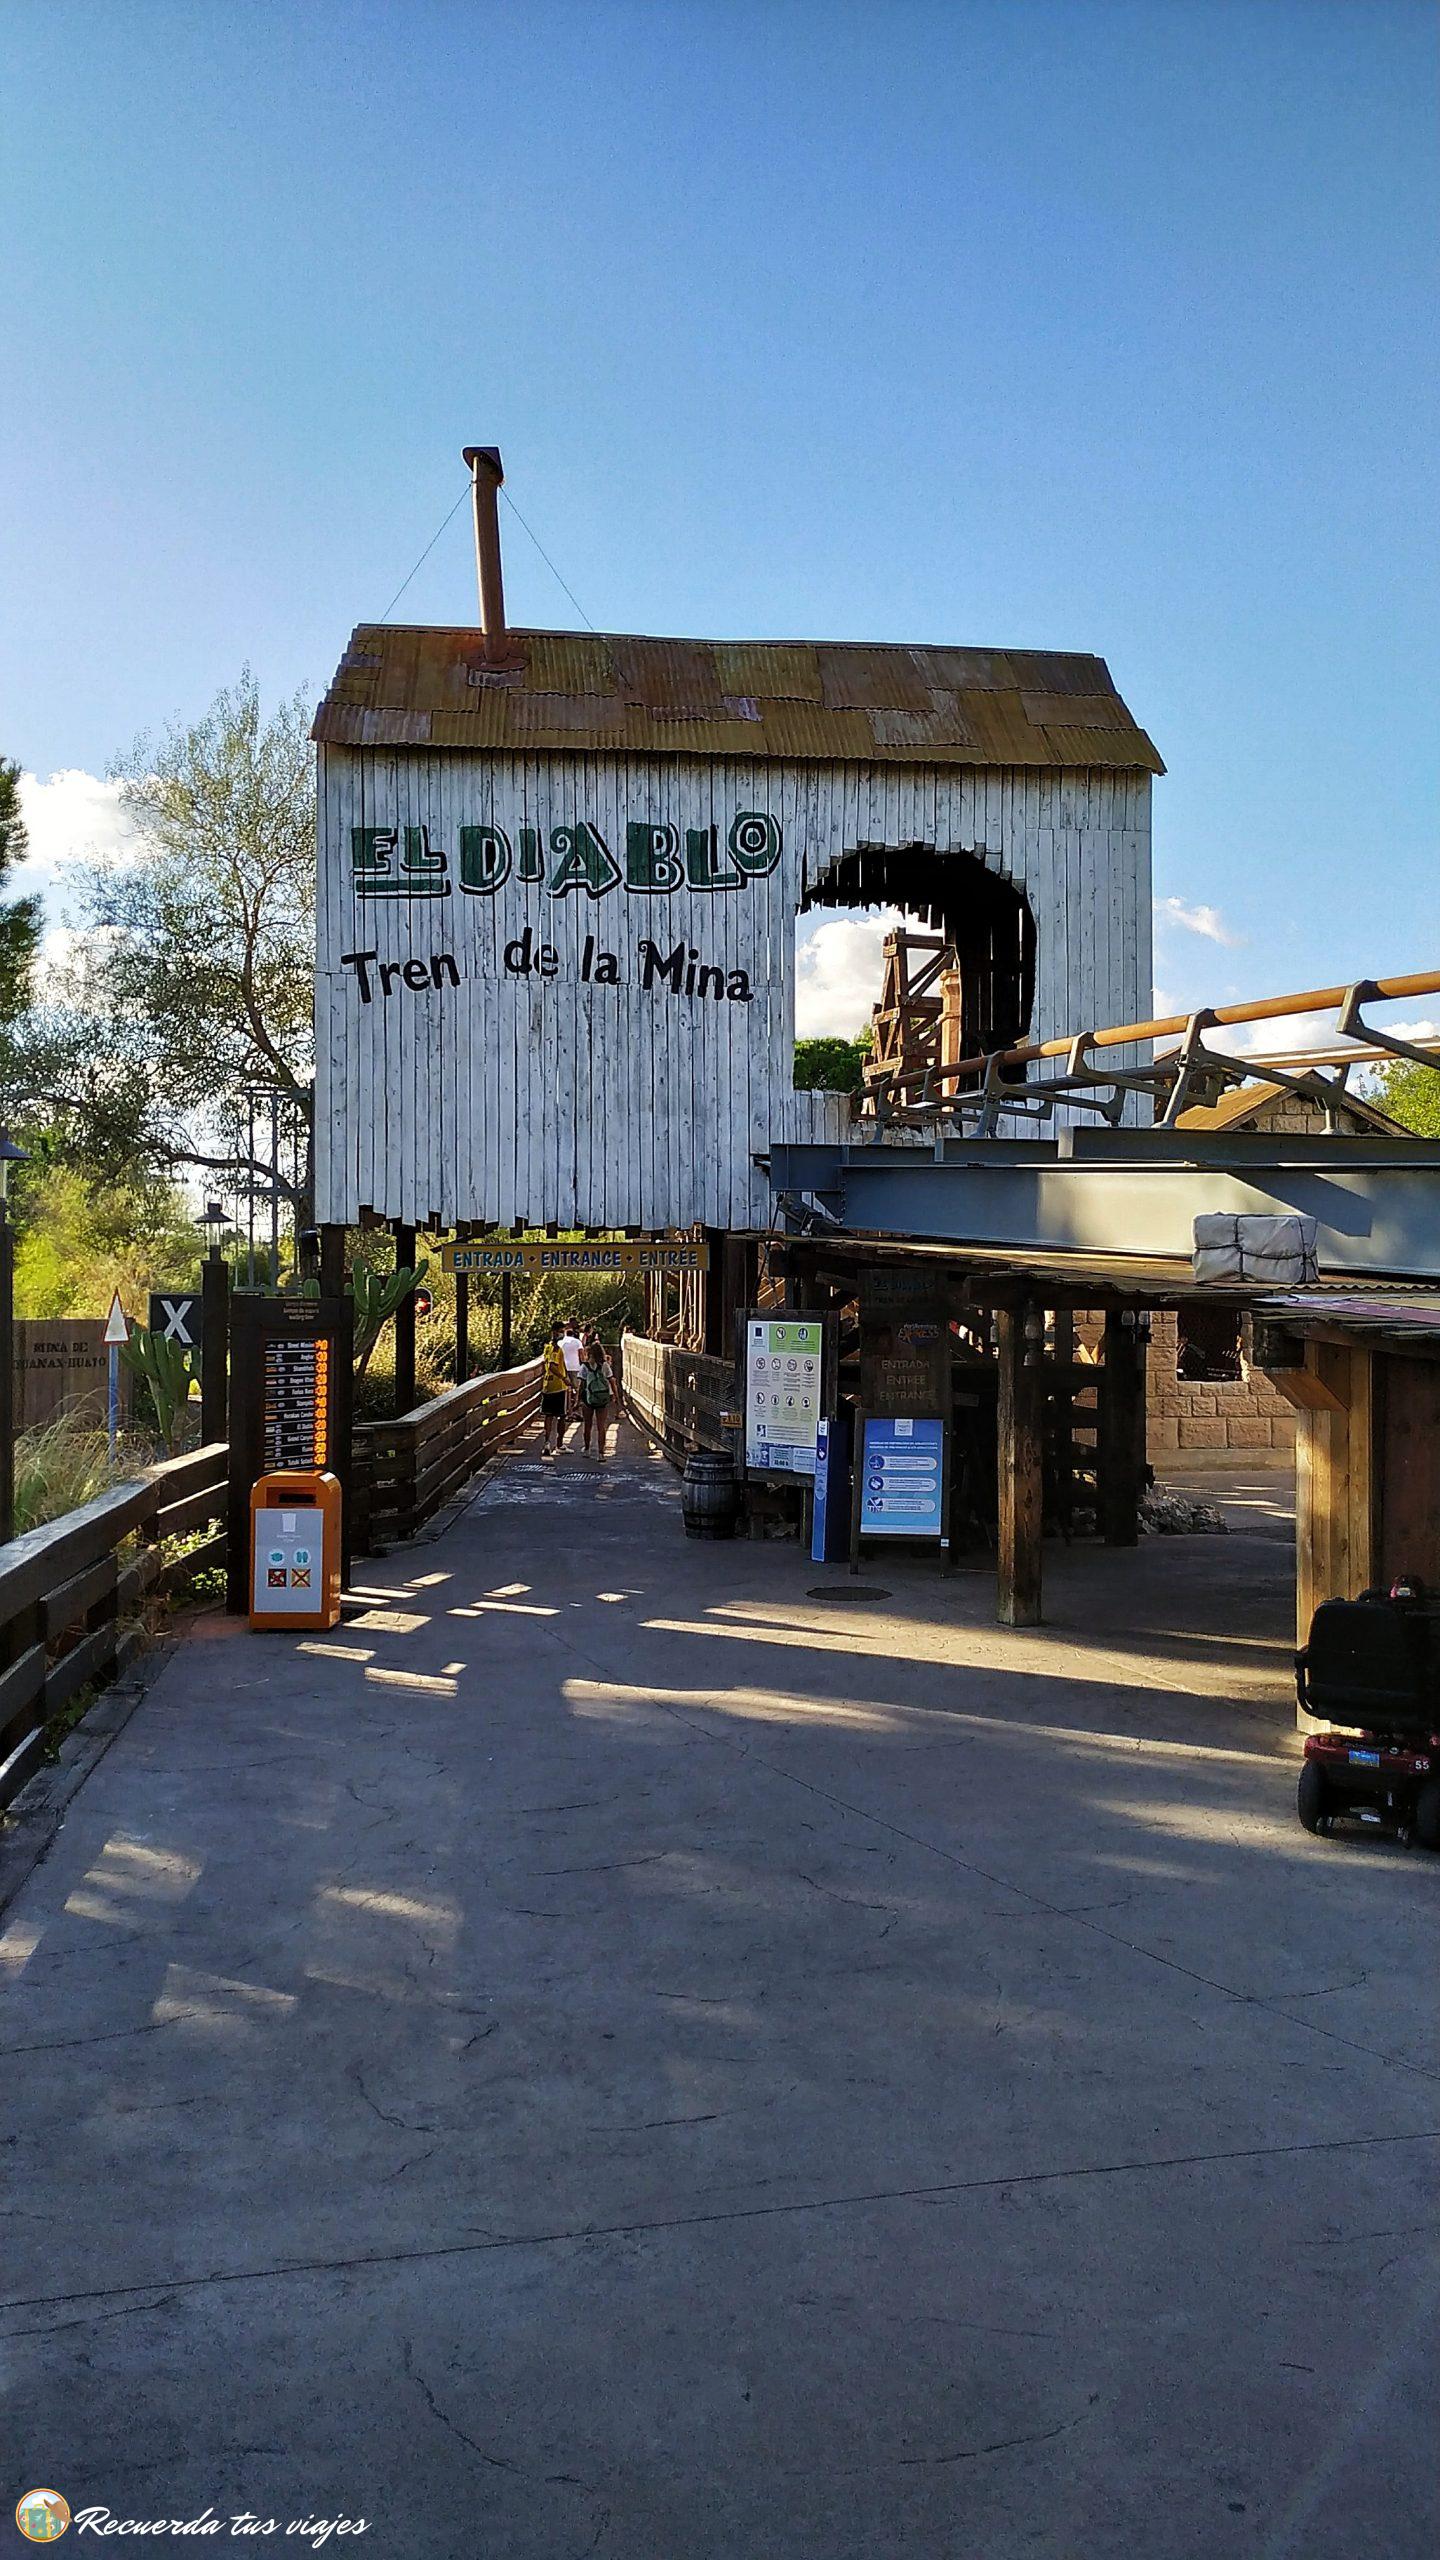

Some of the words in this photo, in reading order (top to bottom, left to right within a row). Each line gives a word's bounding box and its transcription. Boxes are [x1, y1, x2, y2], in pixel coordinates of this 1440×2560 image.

[350, 825, 447, 876] EL
[458, 810, 784, 900] DIABLO
[340, 948, 462, 1004] Tren
[502, 925, 559, 978] de
[580, 934, 620, 985] la
[637, 938, 755, 1003] Mina
[453, 1249, 525, 1269] ENTRADA
[540, 1249, 622, 1269] ENTRANCE
[638, 1245, 699, 1268] ENTRÉE
[160, 1300, 194, 1344] X
[72, 1342, 89, 1353] DE
[881, 1359, 930, 1370] ENTRADA
